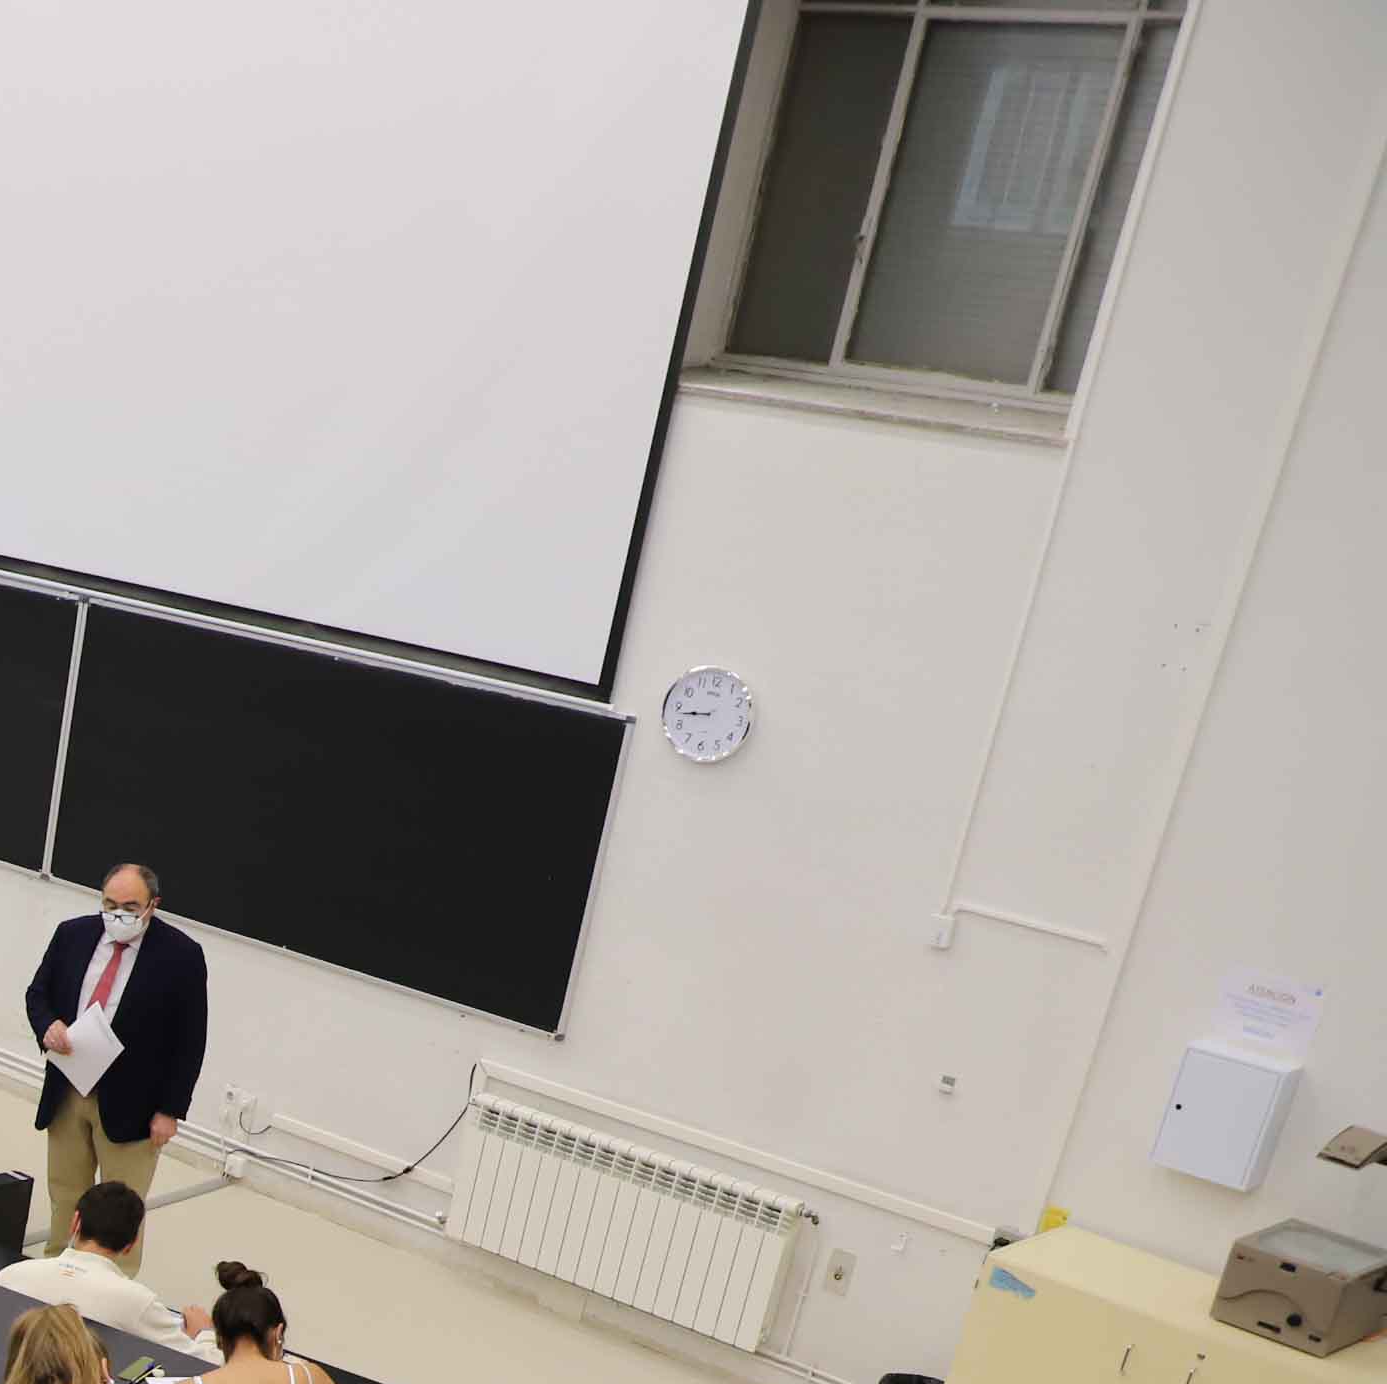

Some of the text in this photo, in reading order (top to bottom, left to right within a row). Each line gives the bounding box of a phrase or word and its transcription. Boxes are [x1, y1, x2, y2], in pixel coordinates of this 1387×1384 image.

[698, 677, 707, 688] 11
[712, 676, 723, 688] 12
[684, 687, 694, 698] 10
[675, 702, 682, 712] 9
[735, 697, 743, 708] 2
[675, 719, 683, 730] 8
[735, 716, 743, 727] 3
[684, 733, 692, 743] 7
[727, 731, 734, 741] 4
[697, 740, 705, 751] 6
[714, 739, 721, 751] 5
